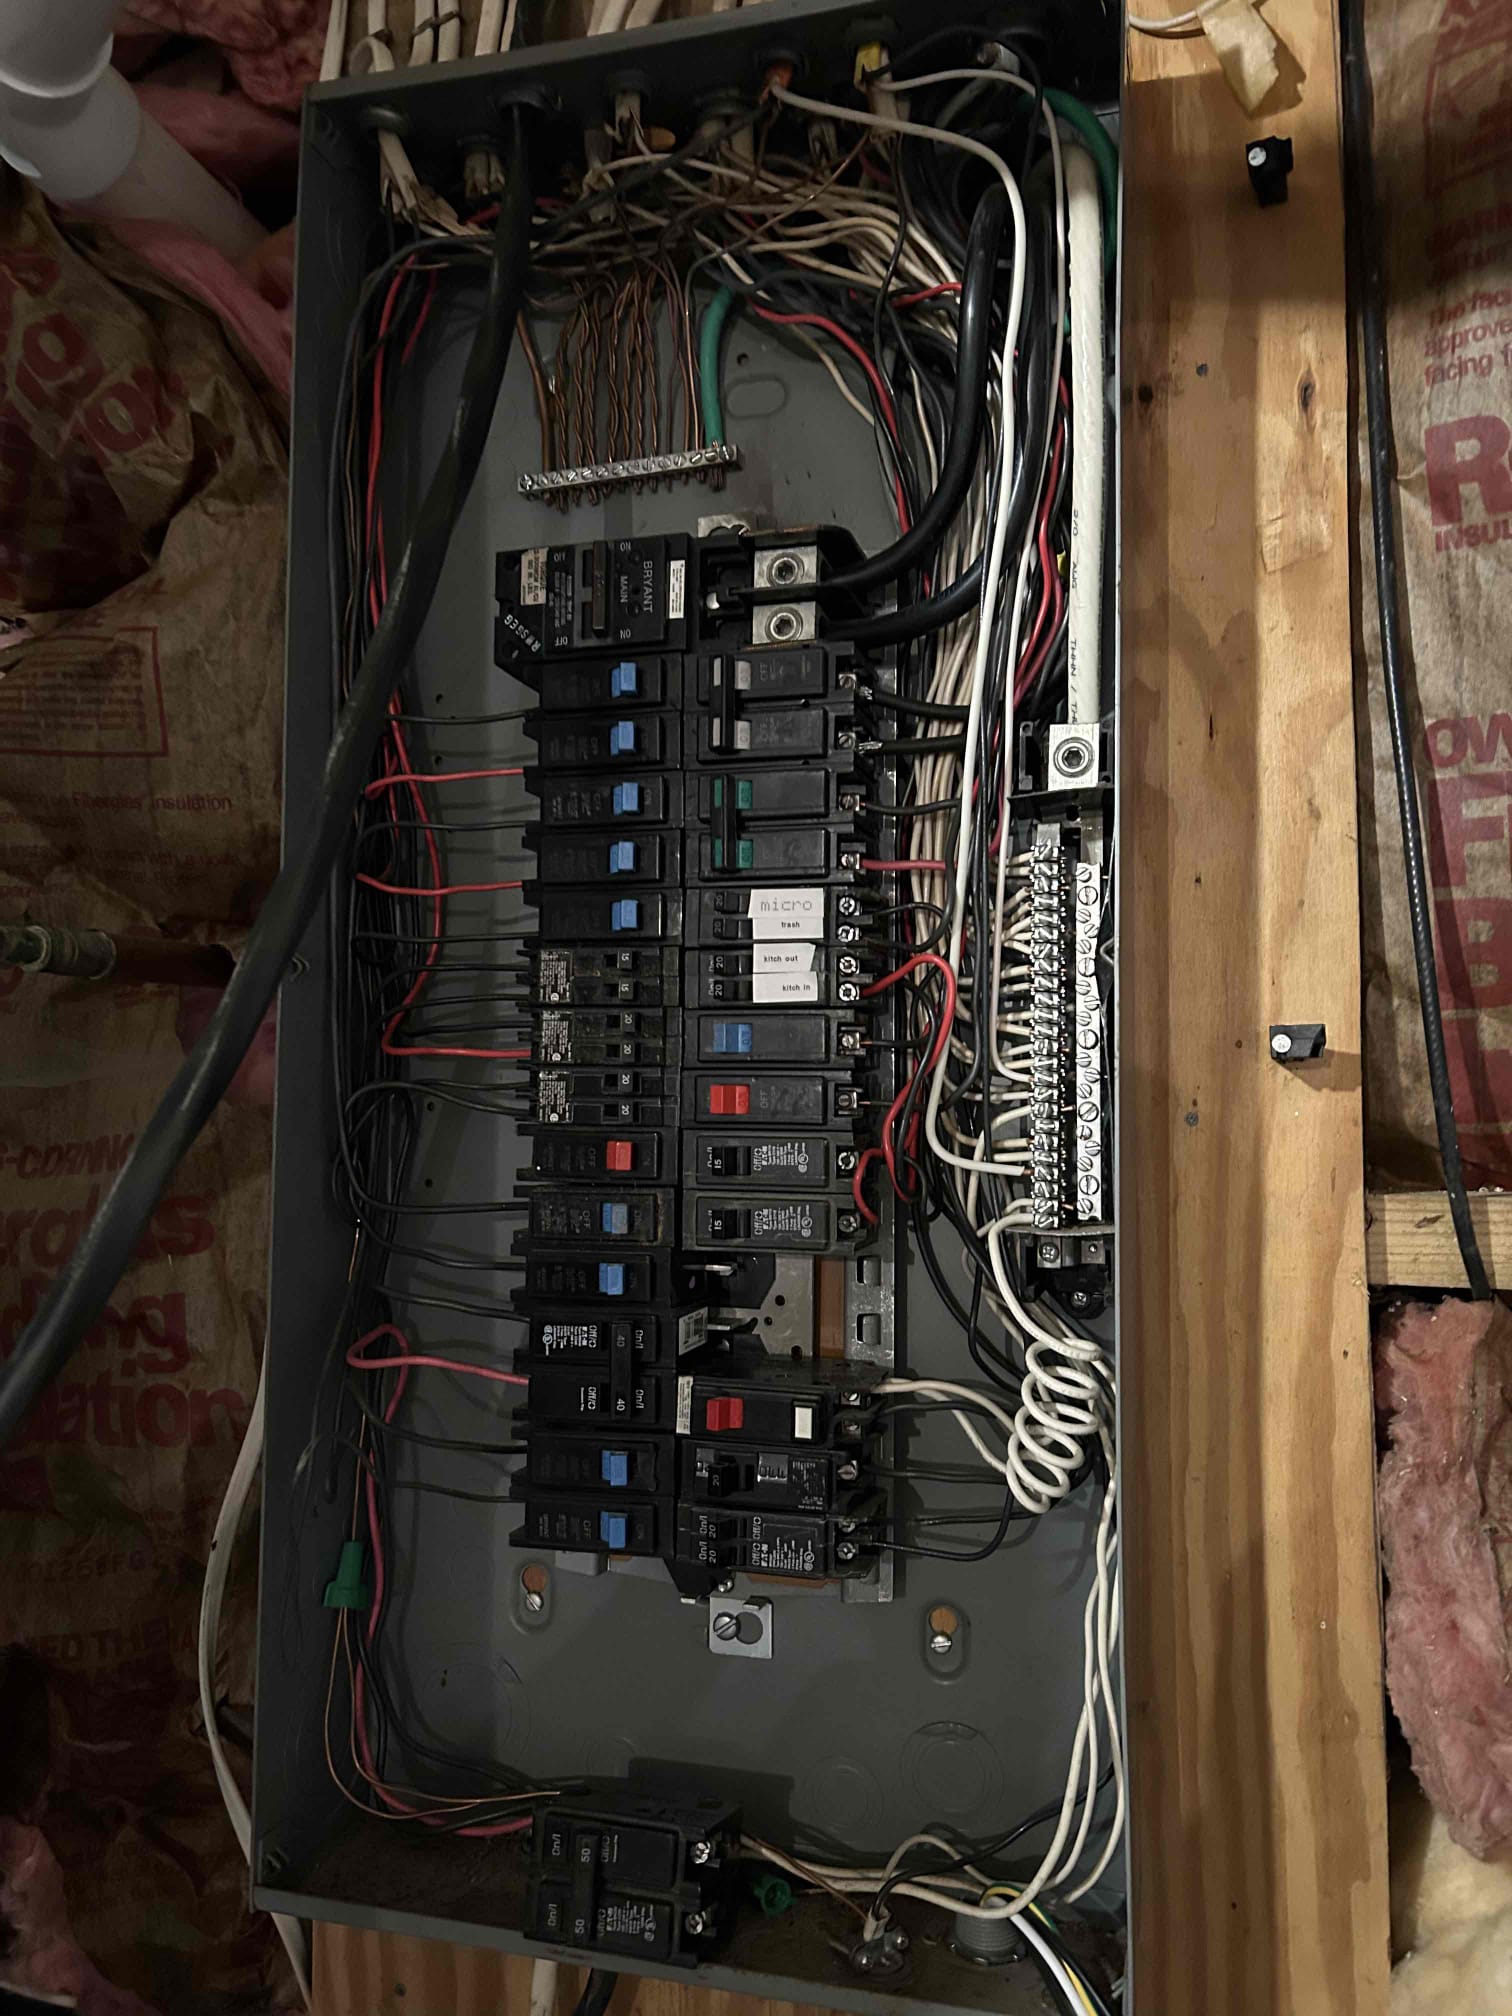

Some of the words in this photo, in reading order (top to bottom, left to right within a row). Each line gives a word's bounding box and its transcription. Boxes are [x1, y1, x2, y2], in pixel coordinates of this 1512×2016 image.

[1425, 415, 1512, 527] R
[619, 575, 629, 604] MAIN
[643, 560, 654, 614] BRYANT
[760, 897, 813, 912] micro
[621, 952, 630, 961] 15
[715, 955, 724, 968] 20
[763, 955, 782, 963] kitch
[621, 983, 630, 992] 15
[715, 983, 723, 997] 20
[782, 984, 800, 992] kitch
[624, 1013, 633, 1024] 20
[623, 1043, 632, 1055] 20
[621, 1073, 630, 1085] 20
[621, 1104, 630, 1116] 20
[714, 1159, 722, 1169] 15
[582, 1209, 591, 1230] OFF
[714, 1219, 722, 1230] 15
[616, 1334, 625, 1348] 40
[615, 1397, 626, 1411] 40
[712, 1473, 720, 1487] 20
[708, 1524, 717, 1539] 20
[708, 1549, 717, 1564] 20
[580, 1847, 591, 1863] 50
[574, 1918, 585, 1935] 50
